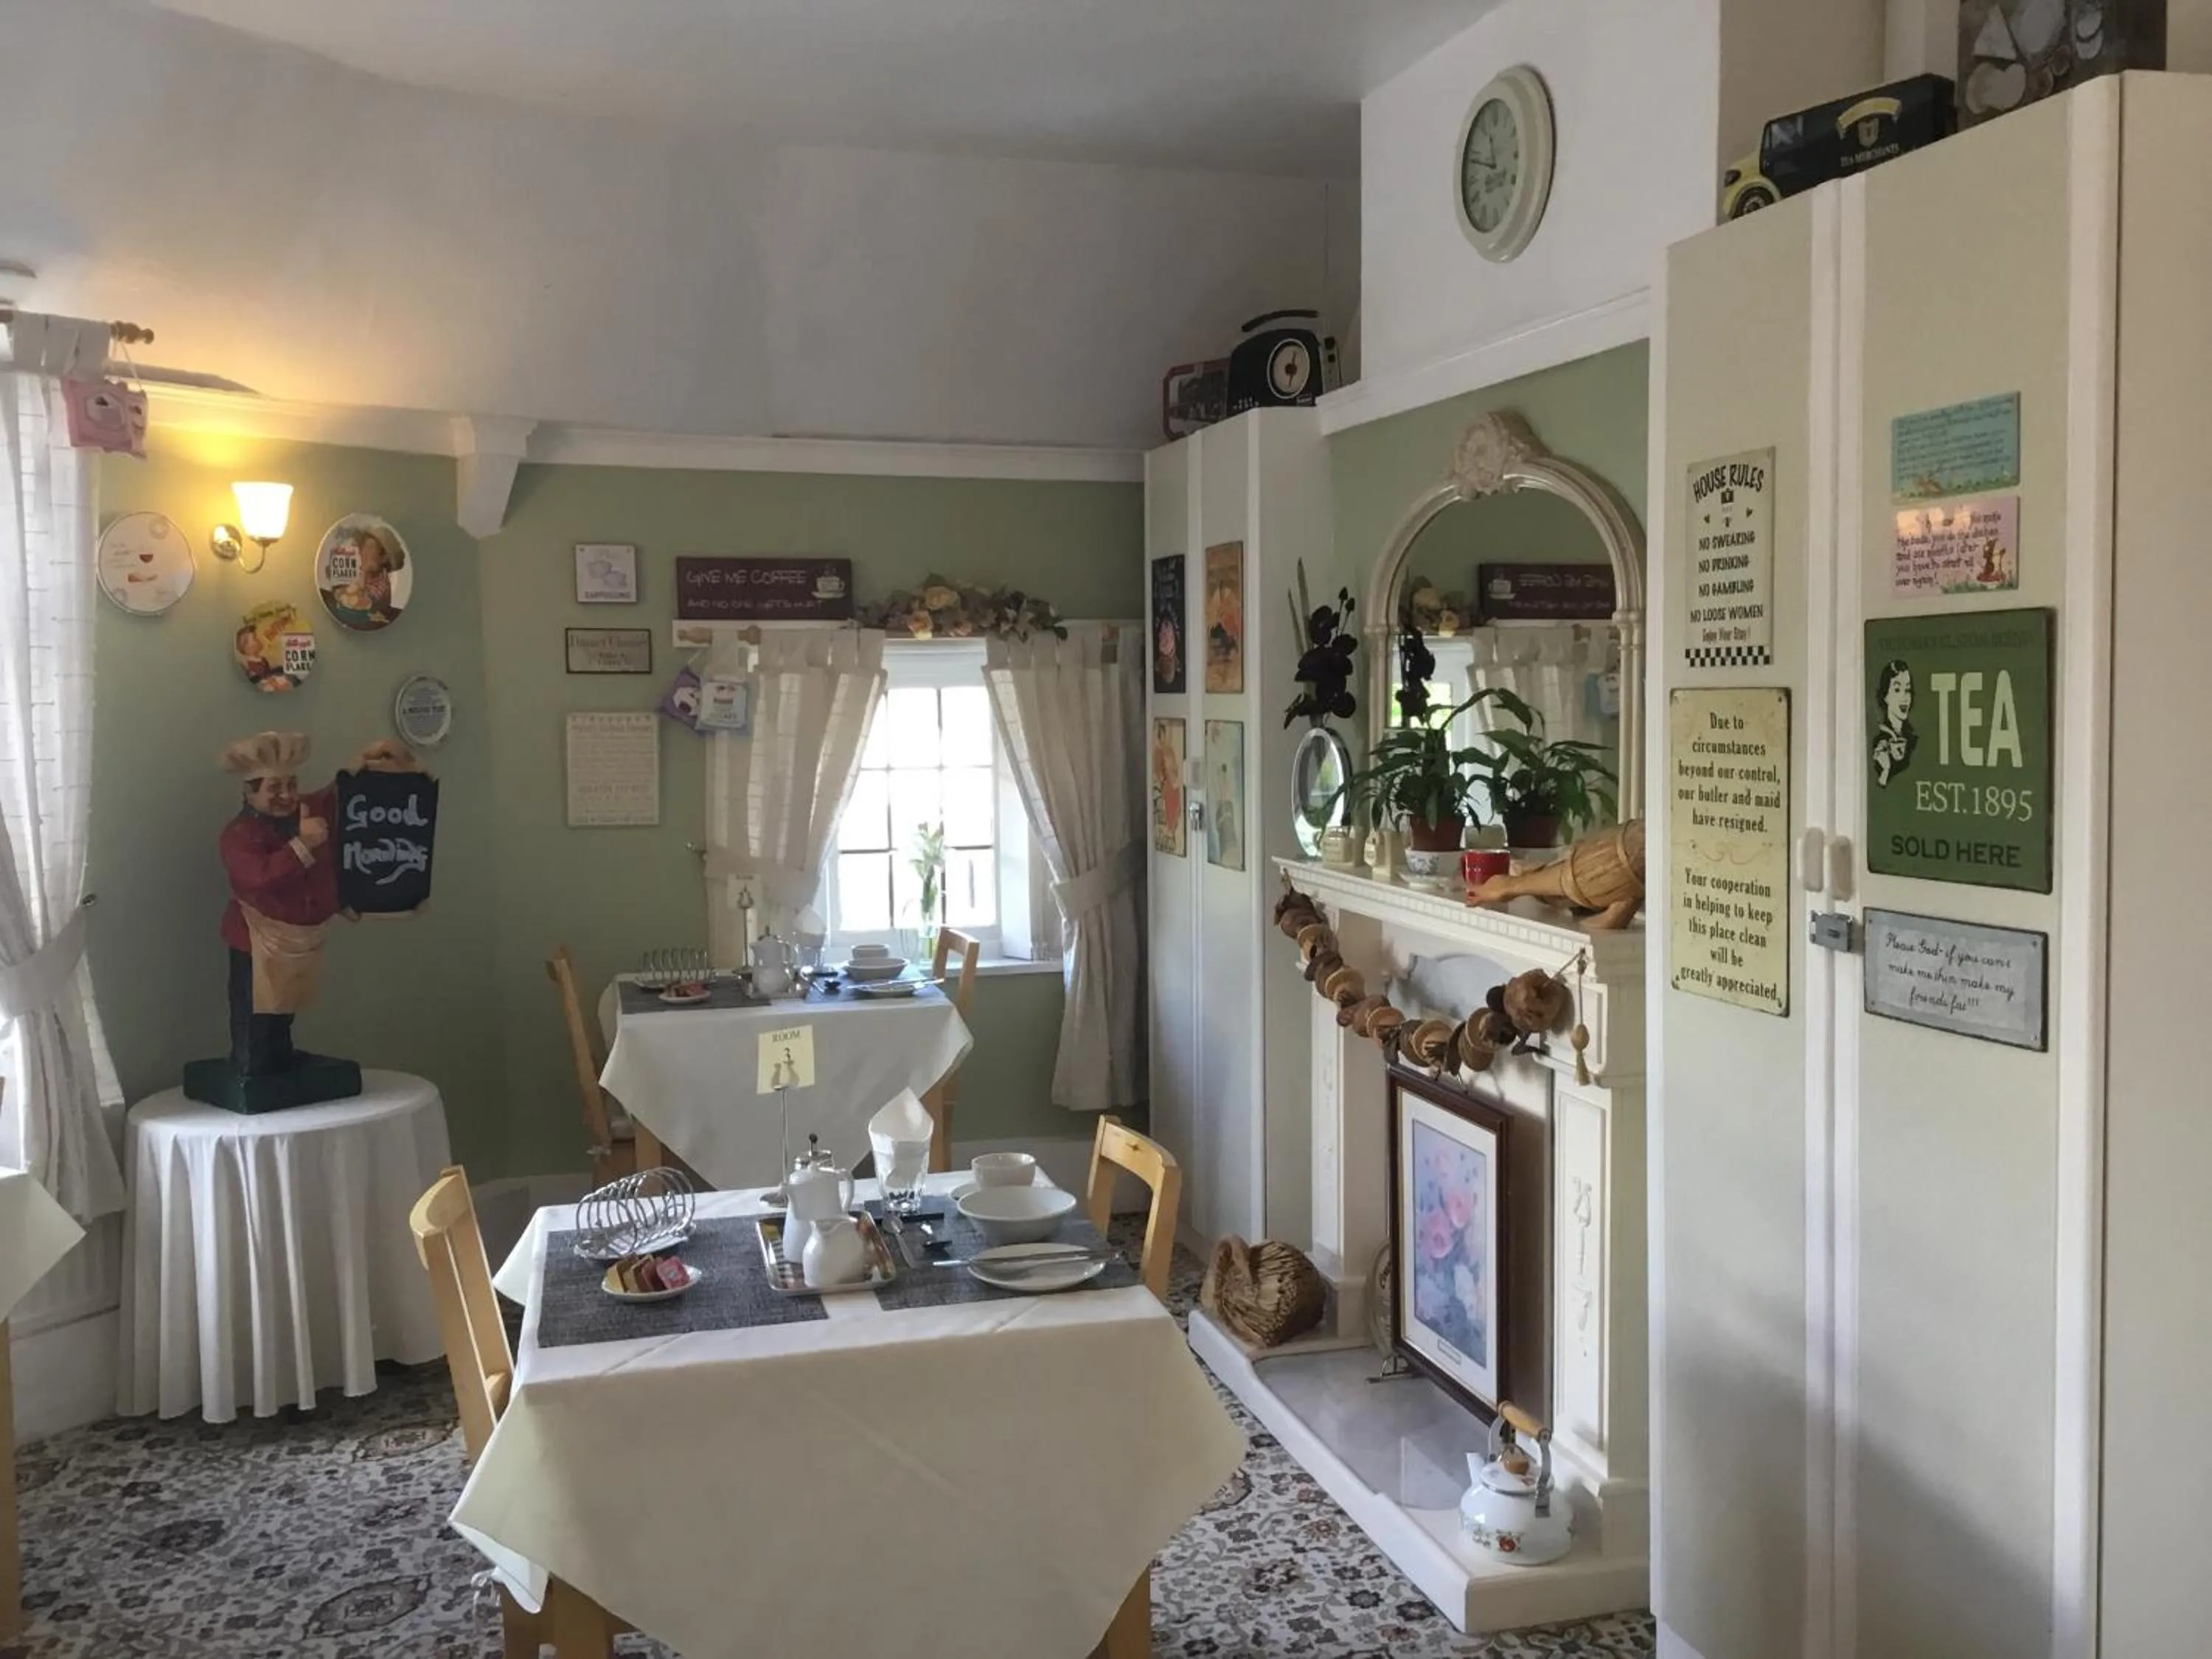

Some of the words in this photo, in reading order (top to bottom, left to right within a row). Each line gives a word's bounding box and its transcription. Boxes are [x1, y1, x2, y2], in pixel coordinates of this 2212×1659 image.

[1693, 465, 1726, 504] HOUSE
[1729, 464, 1764, 493] RULES
[1699, 537, 1710, 551] NO
[1712, 530, 1756, 549] SWEARING
[333, 557, 357, 568] CORN
[1699, 560, 1710, 573] NO
[1712, 554, 1750, 571] DRINKING
[686, 569, 721, 587] GIVE
[725, 569, 747, 584] ME
[750, 569, 807, 585] COFFEE
[1699, 583, 1710, 597] NO
[1712, 578, 1754, 596] GAMBLING
[1690, 609, 1701, 623] NO
[1703, 607, 1726, 622] LOOSE
[1728, 604, 1763, 619] WOMEN
[285, 650, 316, 662] CORN
[1710, 712, 1731, 729] Due
[1733, 715, 1744, 729] to
[1930, 669, 2023, 768] TEA
[1692, 736, 1766, 756] circumstances
[1678, 759, 1714, 779] beyond
[1717, 766, 1735, 779] our
[1738, 765, 1781, 785] control,
[1677, 787, 1694, 800] our
[1698, 784, 1728, 803] butler
[1733, 788, 1751, 806] and
[1755, 790, 1781, 808] maid
[346, 794, 428, 831] Good
[1692, 807, 1716, 827] have
[1719, 813, 1767, 833] resigned.
[1891, 835, 1950, 860] SOLD
[1957, 841, 2022, 868] HERE
[1685, 867, 1707, 885] Your
[1711, 878, 1770, 897] cooperation
[1683, 892, 1692, 908] in
[1695, 893, 1731, 918] helping
[1734, 903, 1744, 919] to
[1747, 902, 1773, 928] keep
[1689, 917, 1706, 936] this
[1710, 922, 1735, 941] place
[1739, 927, 1767, 947] clean
[1711, 946, 1728, 964] will
[1731, 949, 1743, 967] be
[1885, 931, 1916, 951] Please
[1945, 944, 1957, 965] if
[1958, 952, 1978, 967] you
[1680, 966, 1714, 987] greatly
[1888, 961, 1914, 976] make
[1916, 969, 1933, 979] me
[1934, 967, 1956, 984] thin
[1961, 975, 1992, 990] make
[1994, 984, 2014, 1001] my
[1909, 986, 1948, 1007] friends
[772, 1029, 800, 1043] ROOM
